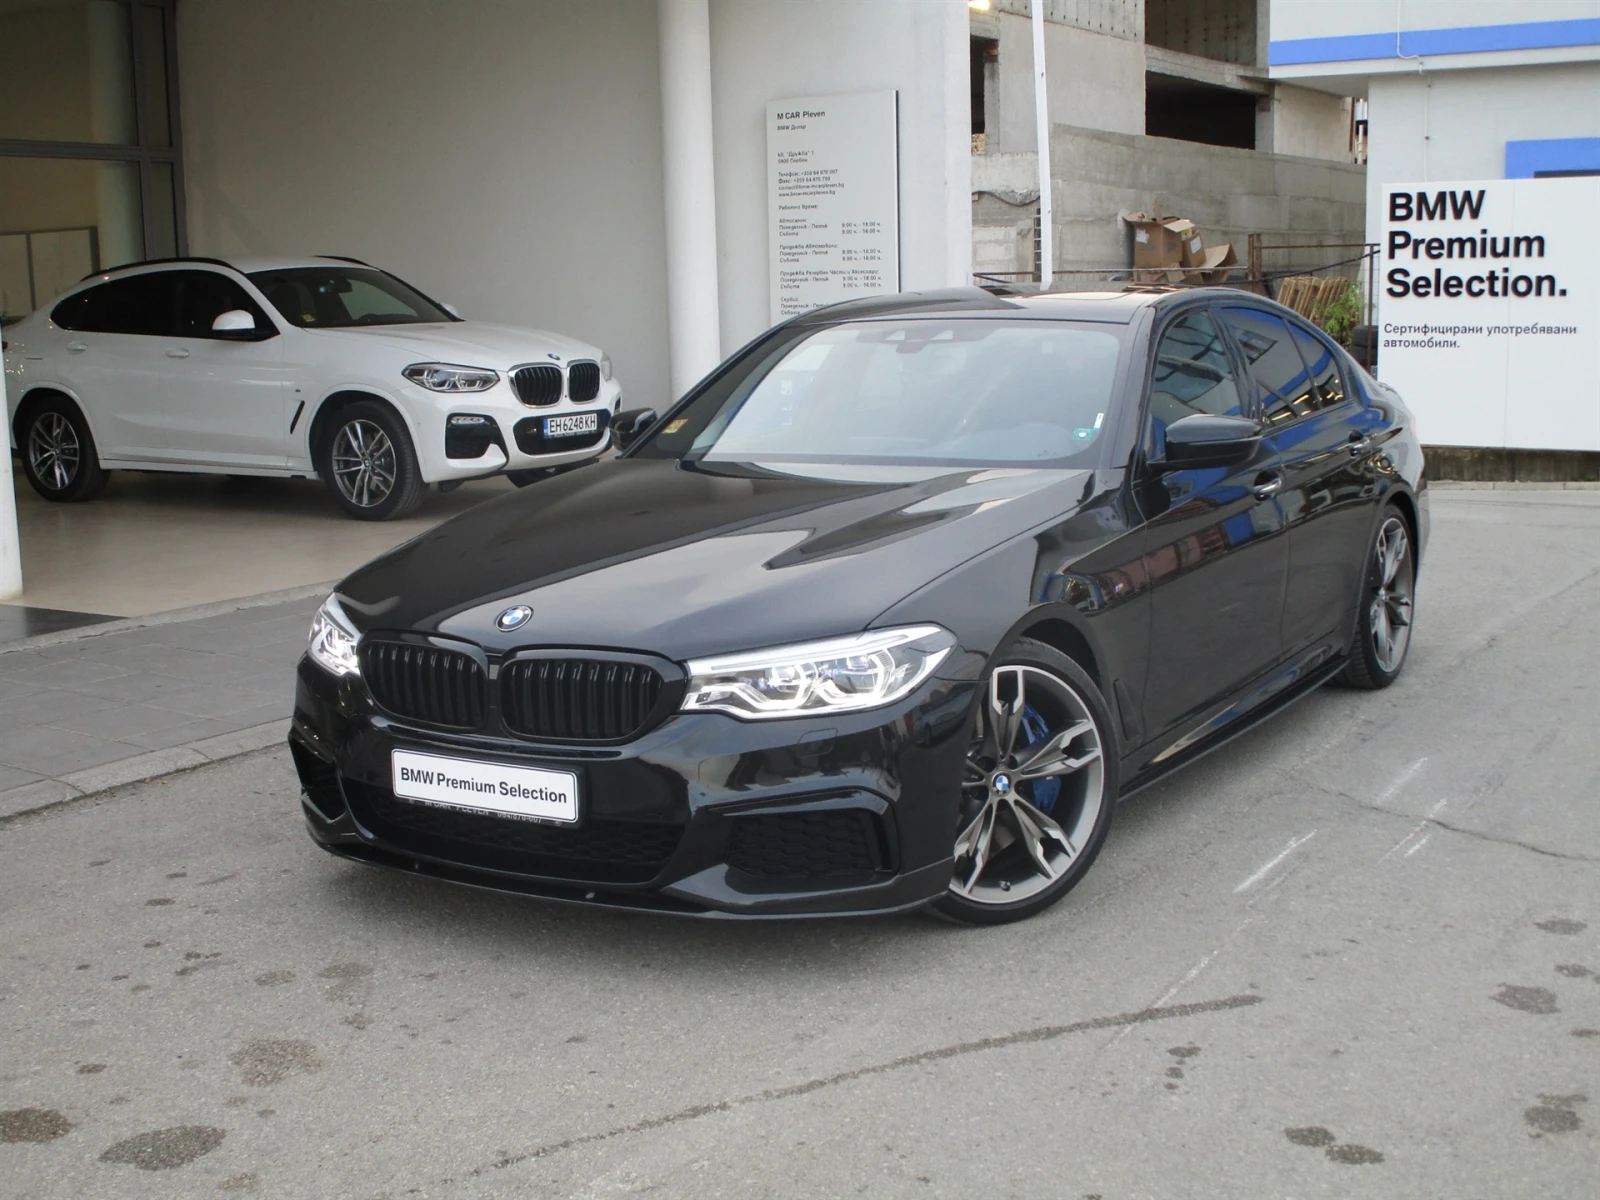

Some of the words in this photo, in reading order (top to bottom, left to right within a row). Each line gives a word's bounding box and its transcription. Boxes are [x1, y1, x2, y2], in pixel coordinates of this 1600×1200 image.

[785, 111, 800, 119] CAR
[802, 110, 826, 118] Pleven
[1389, 189, 1486, 222] BMW
[1388, 228, 1545, 260] Premium
[1386, 267, 1568, 298] Selection.
[1383, 337, 1460, 348] автомобили.
[1384, 323, 1483, 336] Сертифицирани
[1486, 323, 1577, 336] употребявани
[401, 767, 434, 785] BMW
[437, 773, 496, 794] Premium
[500, 782, 567, 804] Selection
